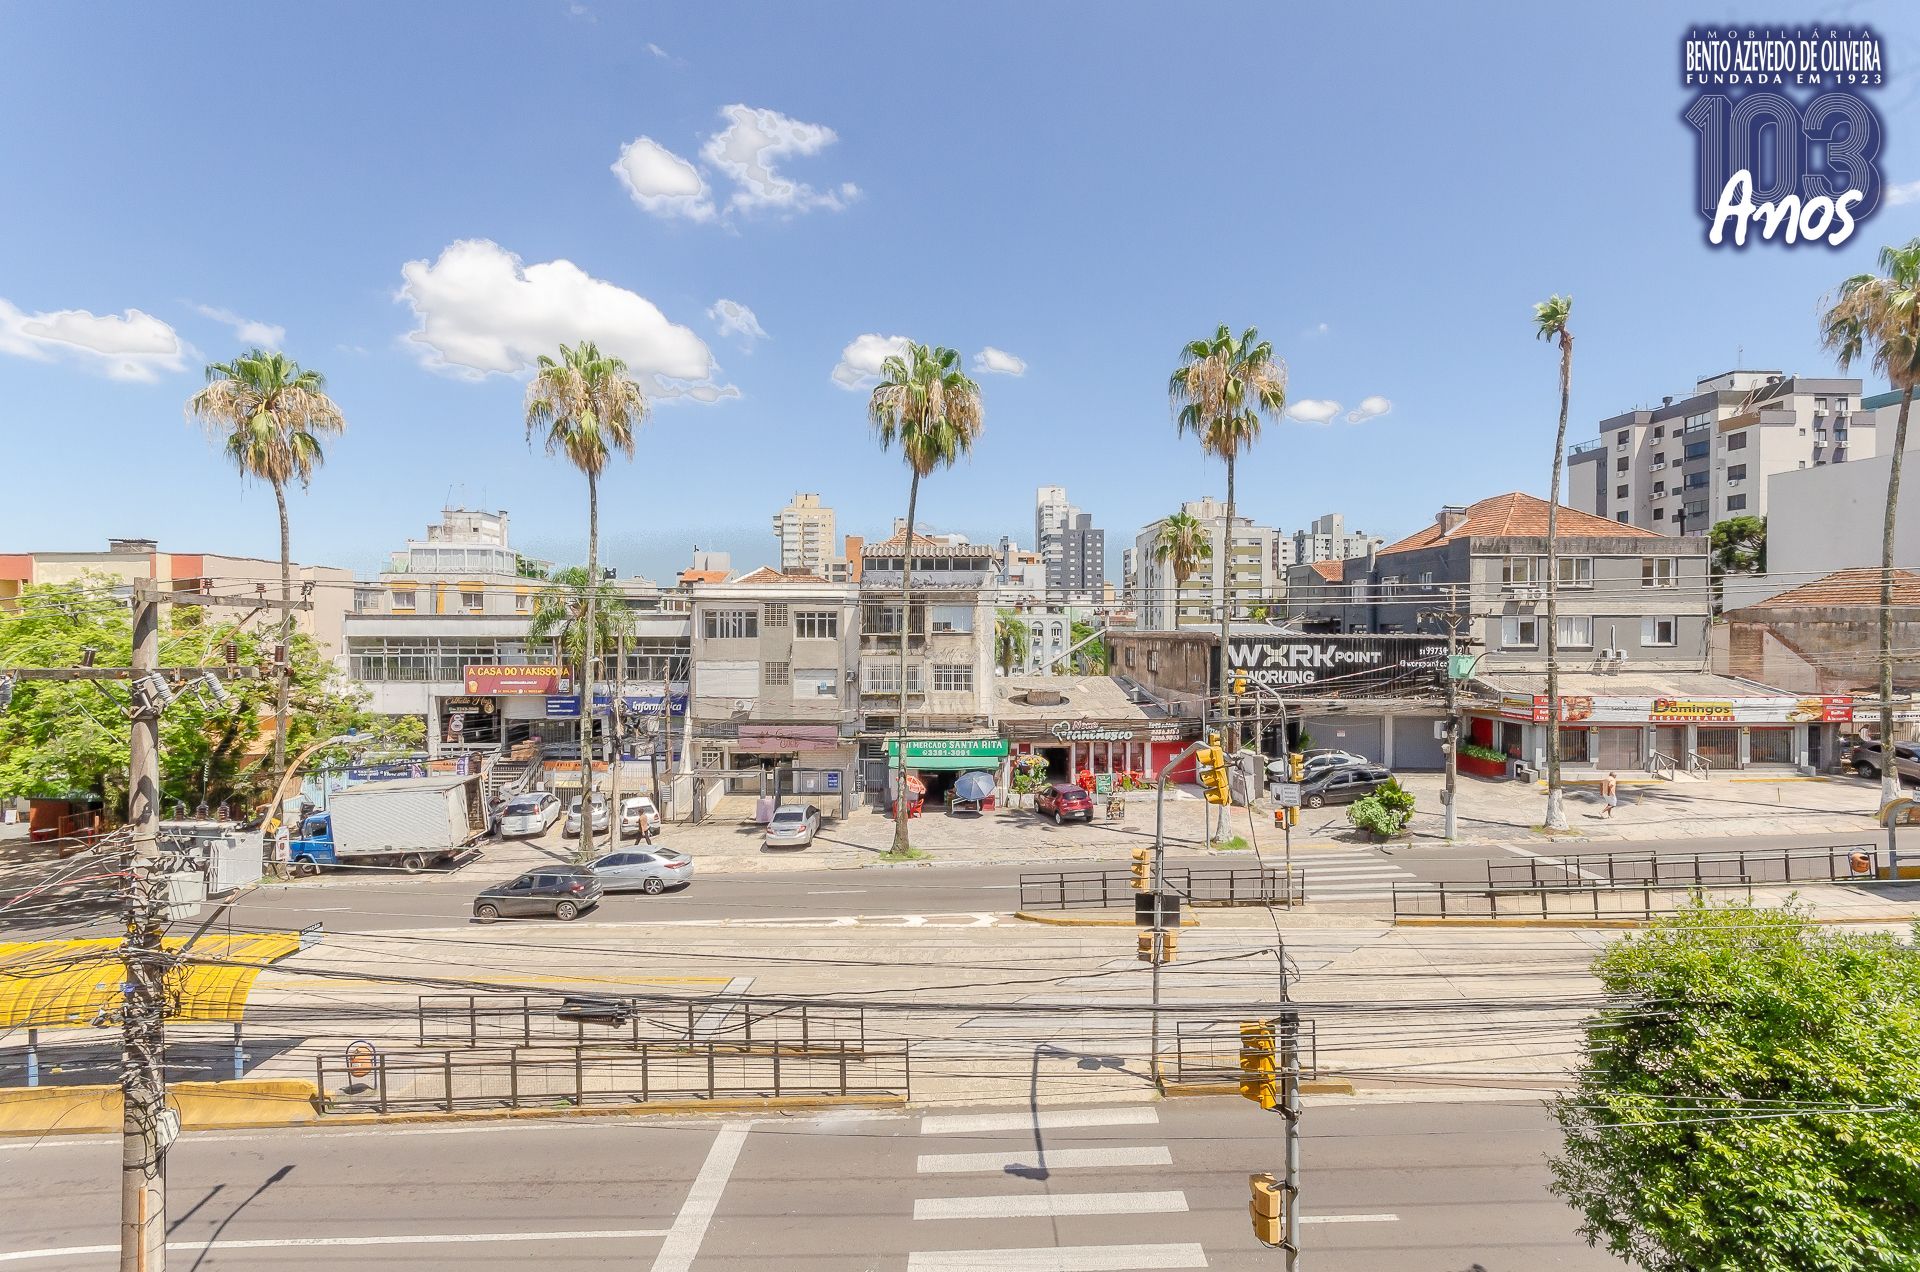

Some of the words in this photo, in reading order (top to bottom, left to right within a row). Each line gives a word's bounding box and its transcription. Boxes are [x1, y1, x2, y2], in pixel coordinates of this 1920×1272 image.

[1335, 651, 1382, 664] POINT
[468, 667, 475, 676] A
[477, 667, 502, 676] CASA
[504, 667, 517, 676] DO
[520, 667, 569, 676] YAKISSOA
[1657, 698, 1676, 707] Da
[1654, 700, 1730, 715] Domingos
[913, 741, 947, 749] MERCADO
[949, 740, 979, 749] SANTA
[981, 740, 1003, 749] RITA
